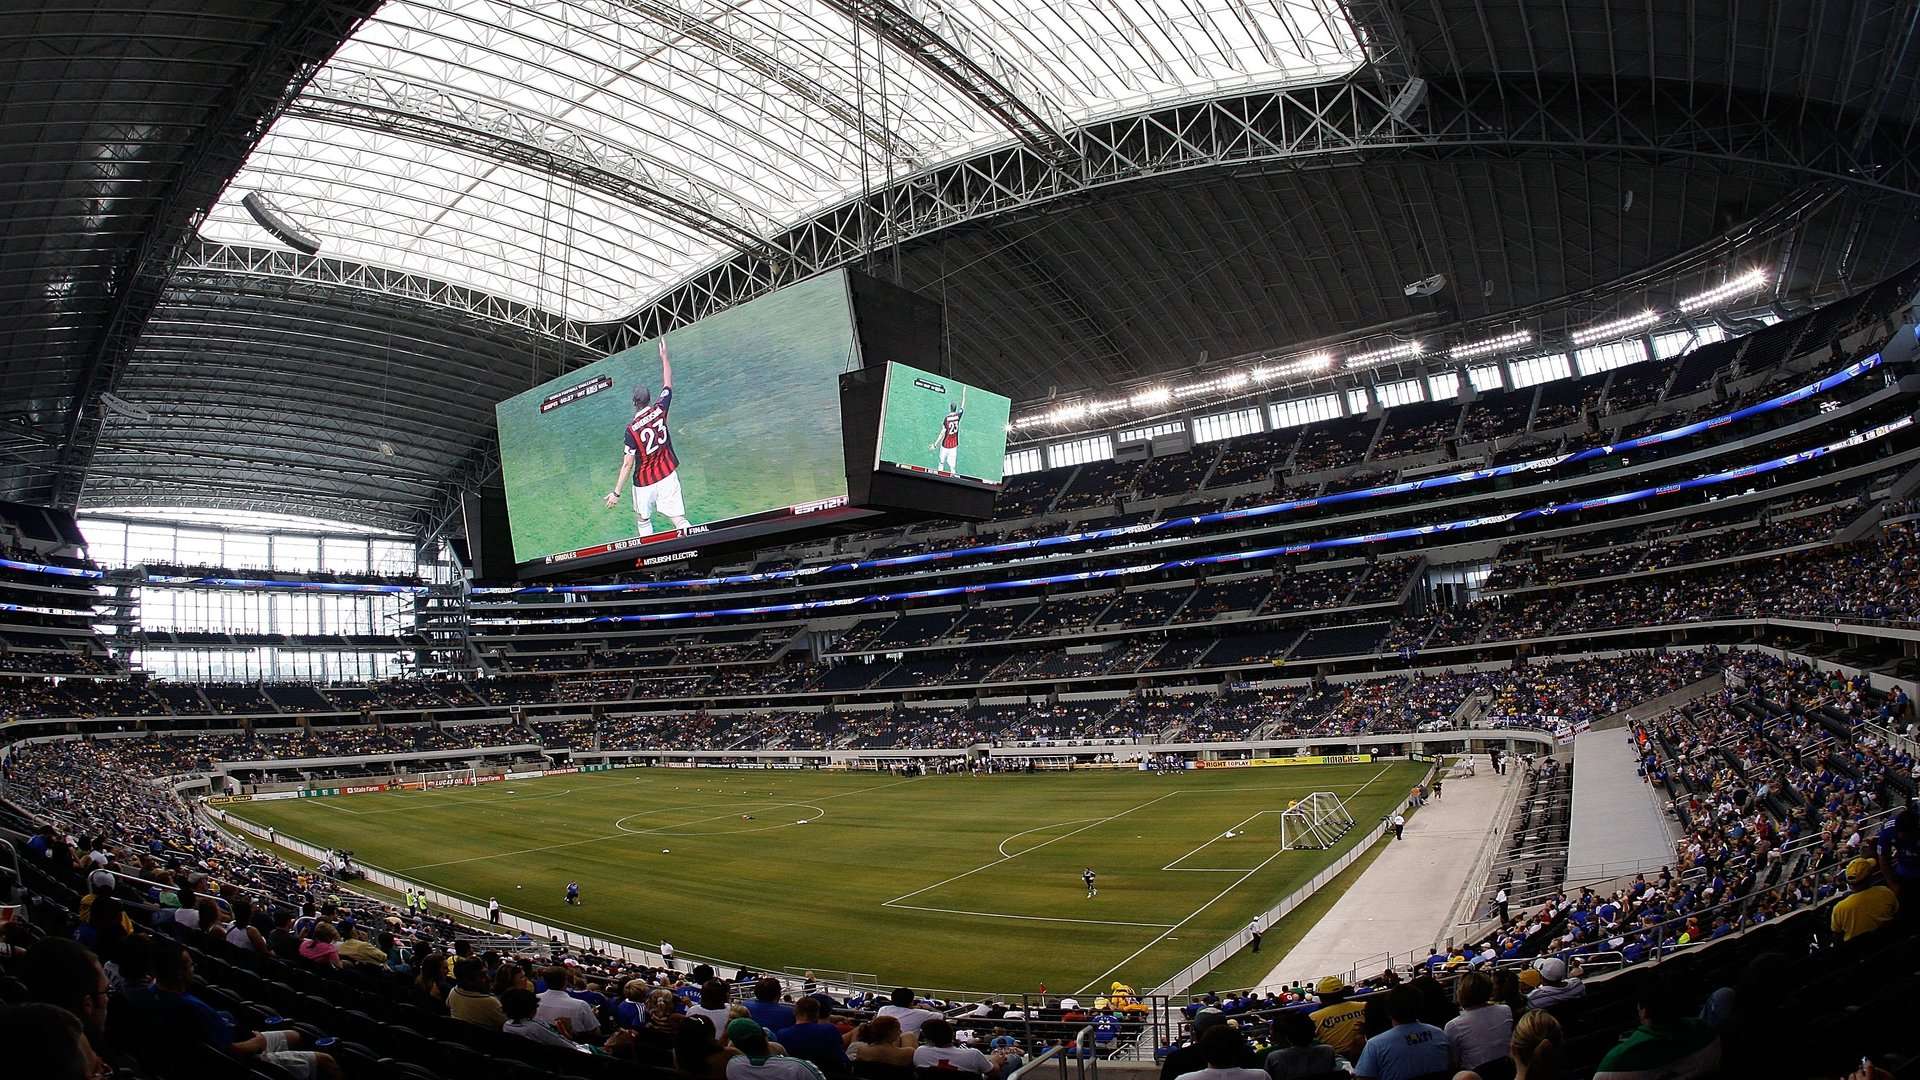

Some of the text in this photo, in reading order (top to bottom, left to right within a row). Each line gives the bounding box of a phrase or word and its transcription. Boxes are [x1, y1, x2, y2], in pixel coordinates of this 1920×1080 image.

[949, 422, 959, 435] 23
[640, 418, 668, 456] 23
[1655, 483, 1681, 494] Academy
[689, 525, 710, 535] FINAL
[554, 551, 577, 562] ORIOLES
[615, 541, 627, 550] RED
[628, 538, 642, 547] SOX
[671, 550, 698, 562] ELECTRIC
[435, 777, 464, 786] LUCAS OIL
[1098, 1019, 1112, 1031] 24
